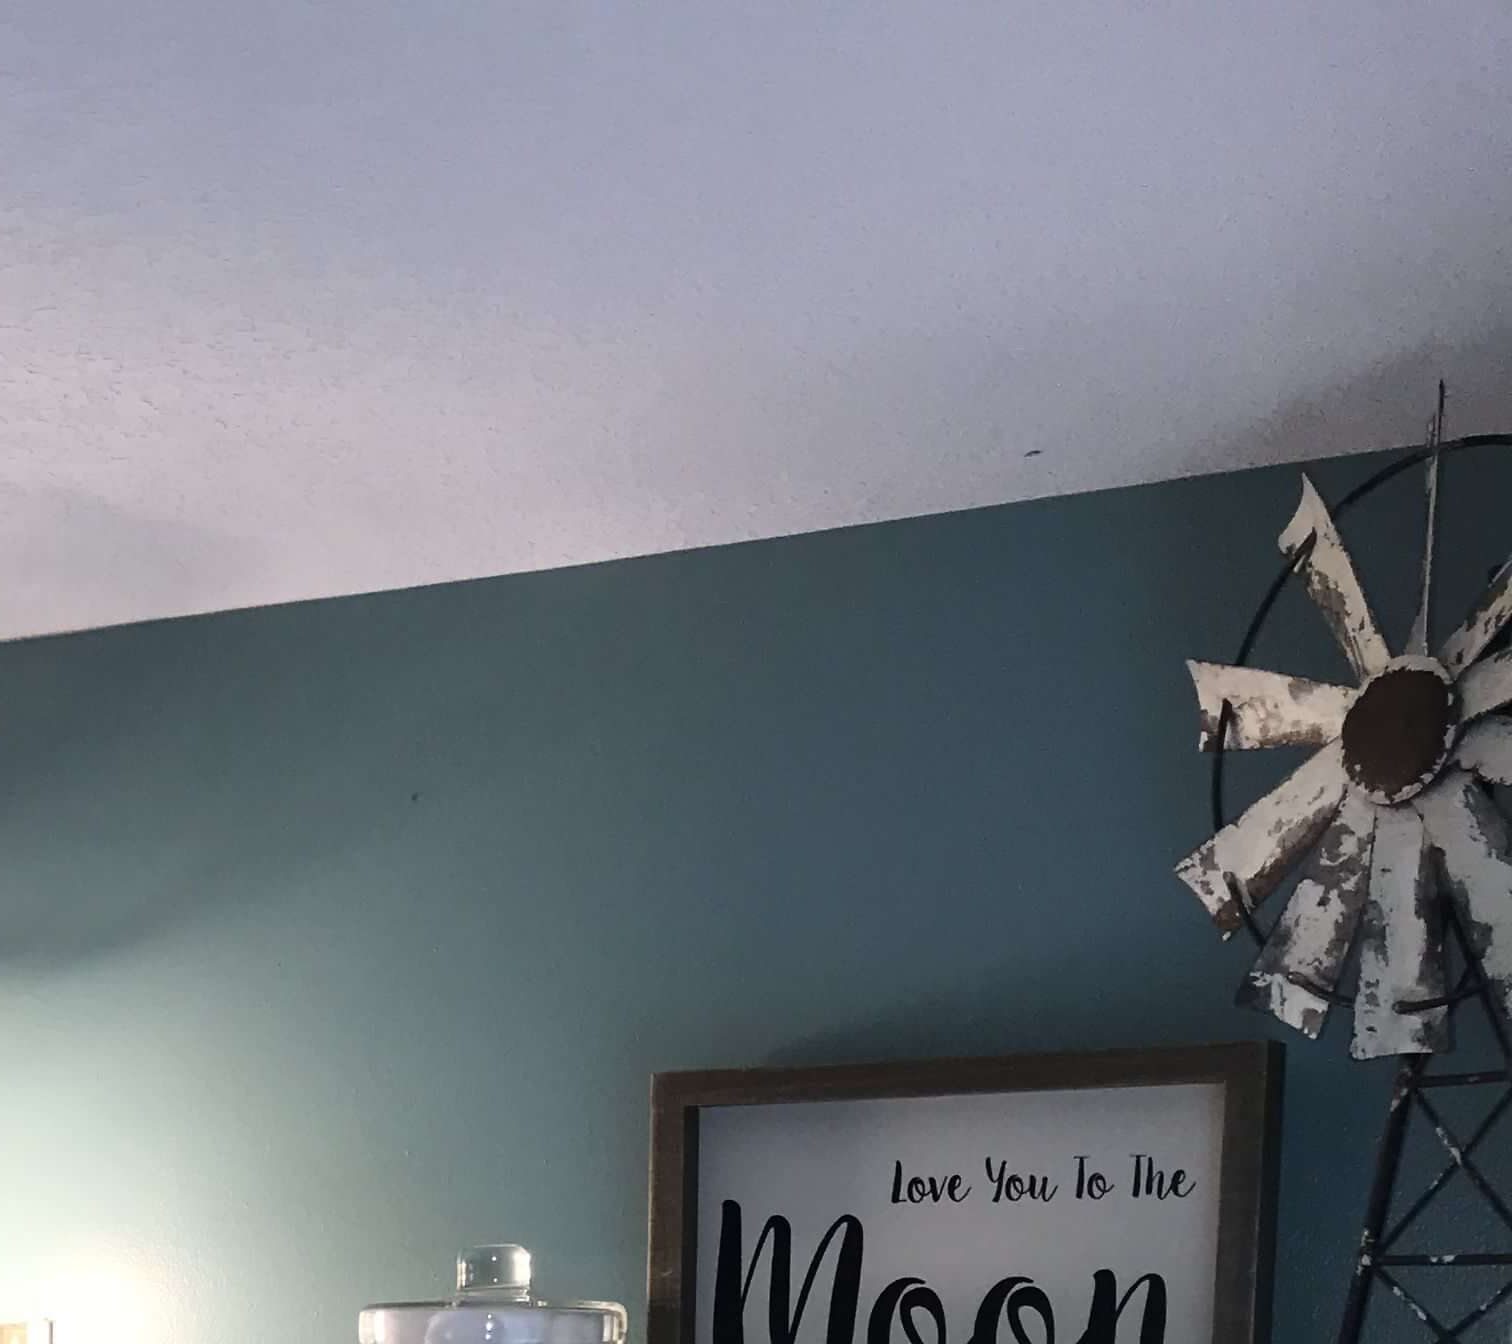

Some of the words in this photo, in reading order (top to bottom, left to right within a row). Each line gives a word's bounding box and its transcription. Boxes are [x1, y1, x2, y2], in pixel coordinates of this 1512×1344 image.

[890, 1160, 971, 1204] Love
[986, 1156, 1058, 1203] You
[1073, 1154, 1115, 1200] To
[1129, 1154, 1196, 1200] The
